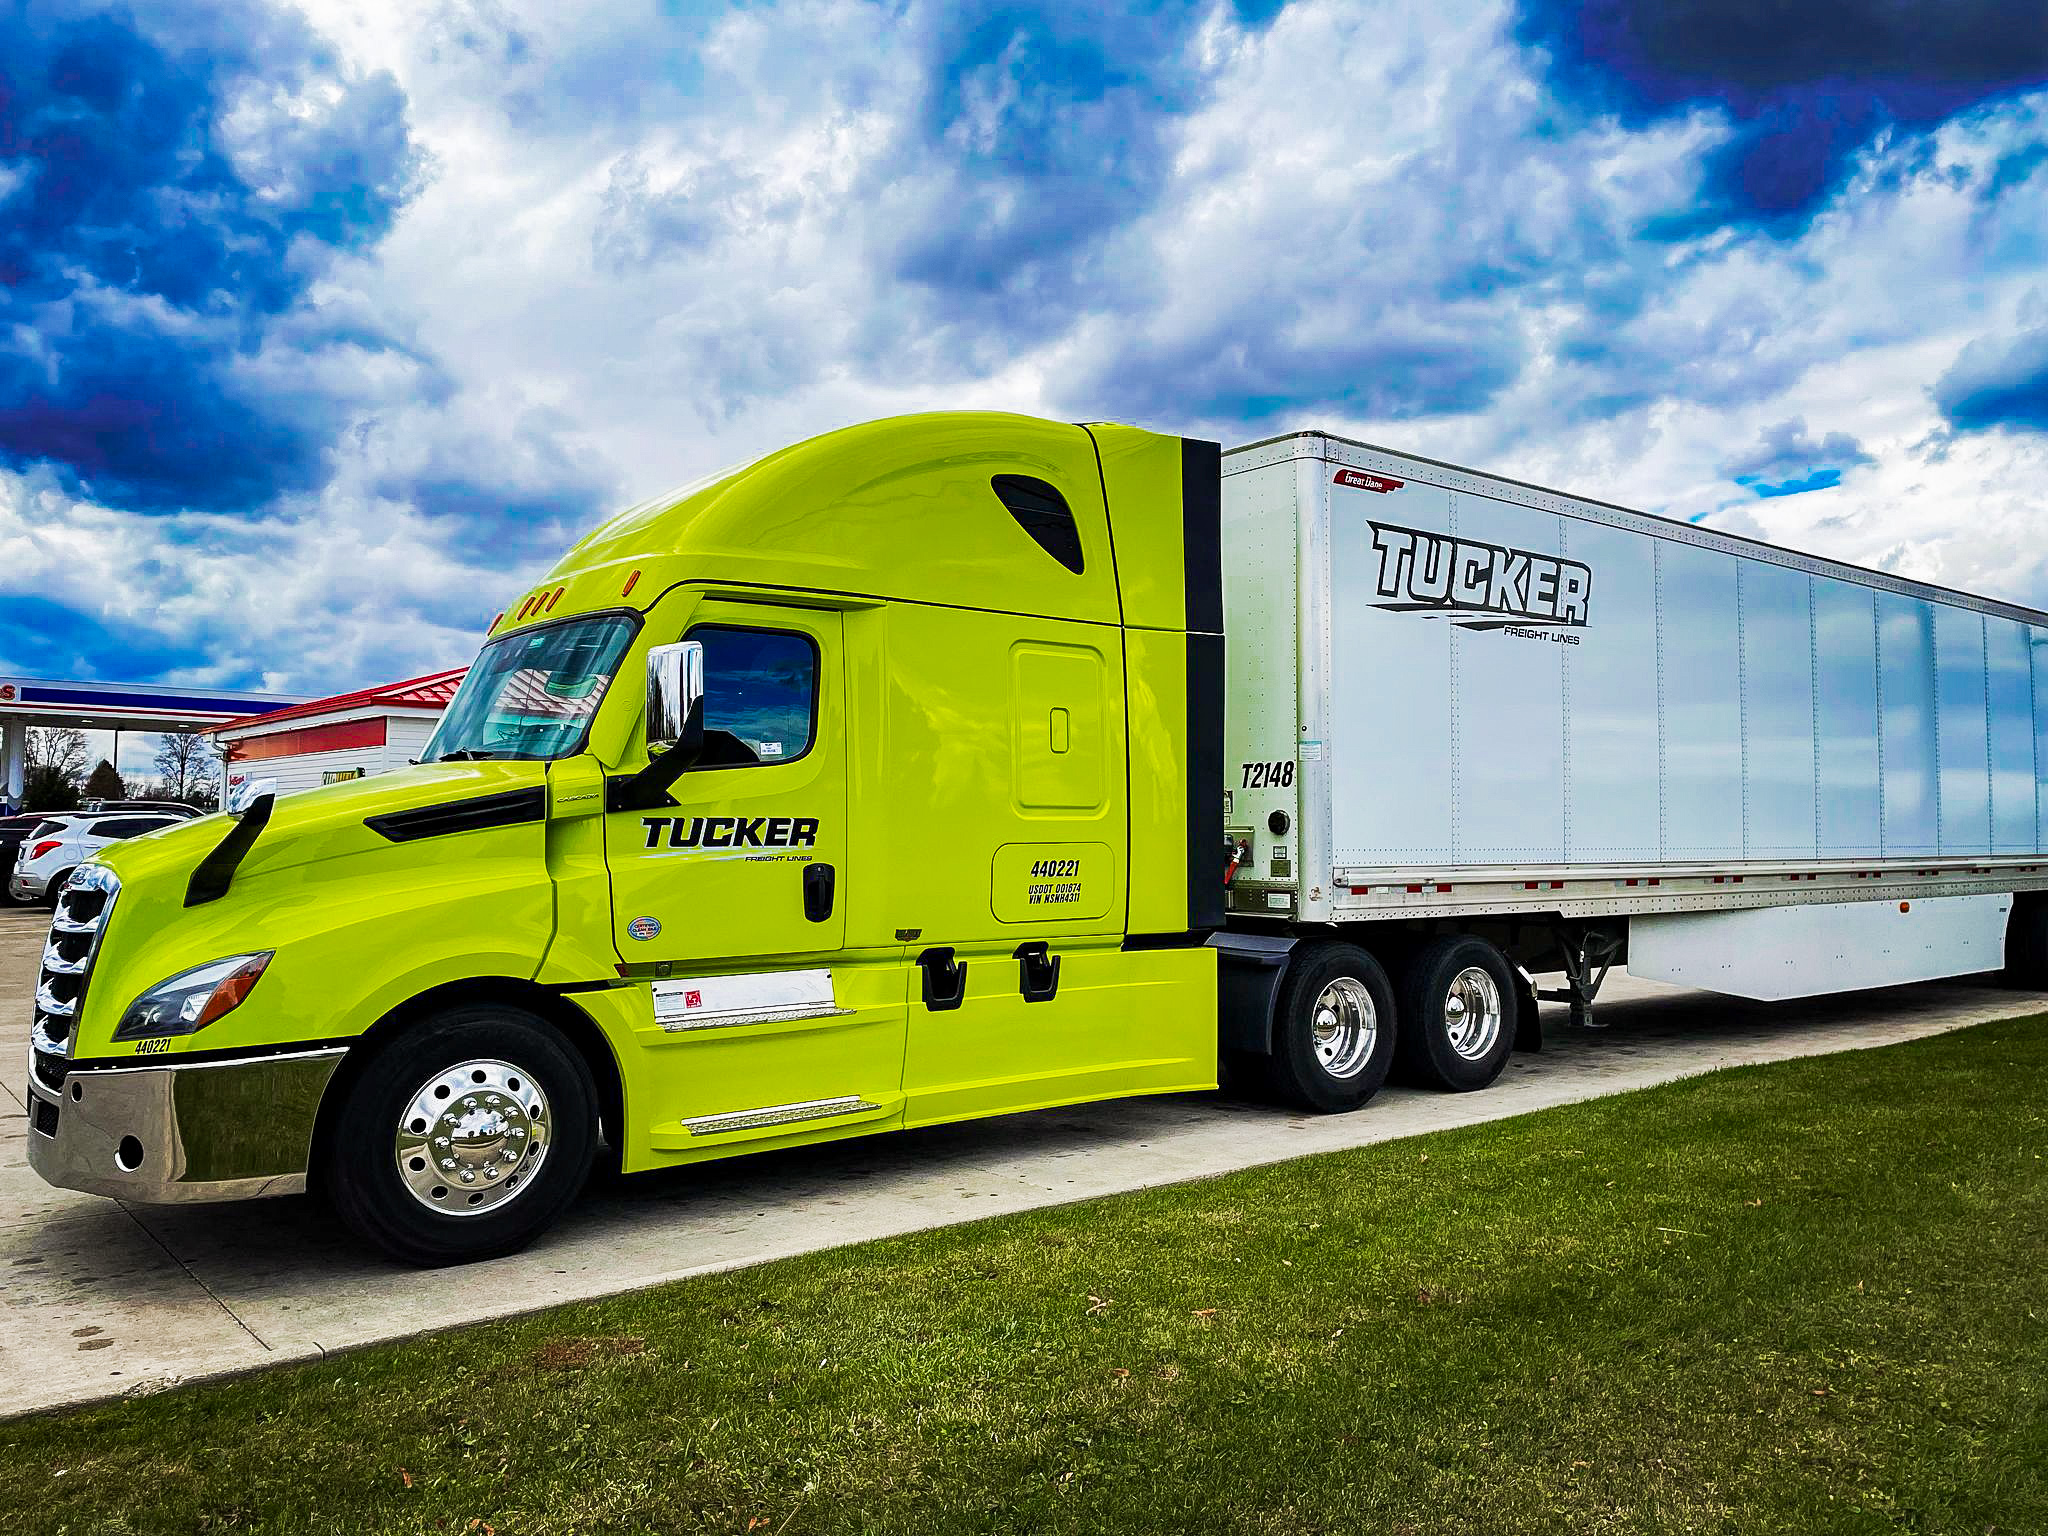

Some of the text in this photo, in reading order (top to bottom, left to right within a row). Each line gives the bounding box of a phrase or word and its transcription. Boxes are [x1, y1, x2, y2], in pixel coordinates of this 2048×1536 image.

[1345, 472, 1365, 486] Great
[1366, 520, 1592, 627] TUCKER
[1504, 626, 1580, 645] FREIGHT LINES
[1242, 760, 1295, 789] T2148
[641, 816, 820, 848] TUCKER
[1031, 860, 1080, 877] 440221
[1028, 884, 1054, 895] USDOT
[1029, 894, 1042, 904] VIN
[135, 1038, 171, 1054] 440221
